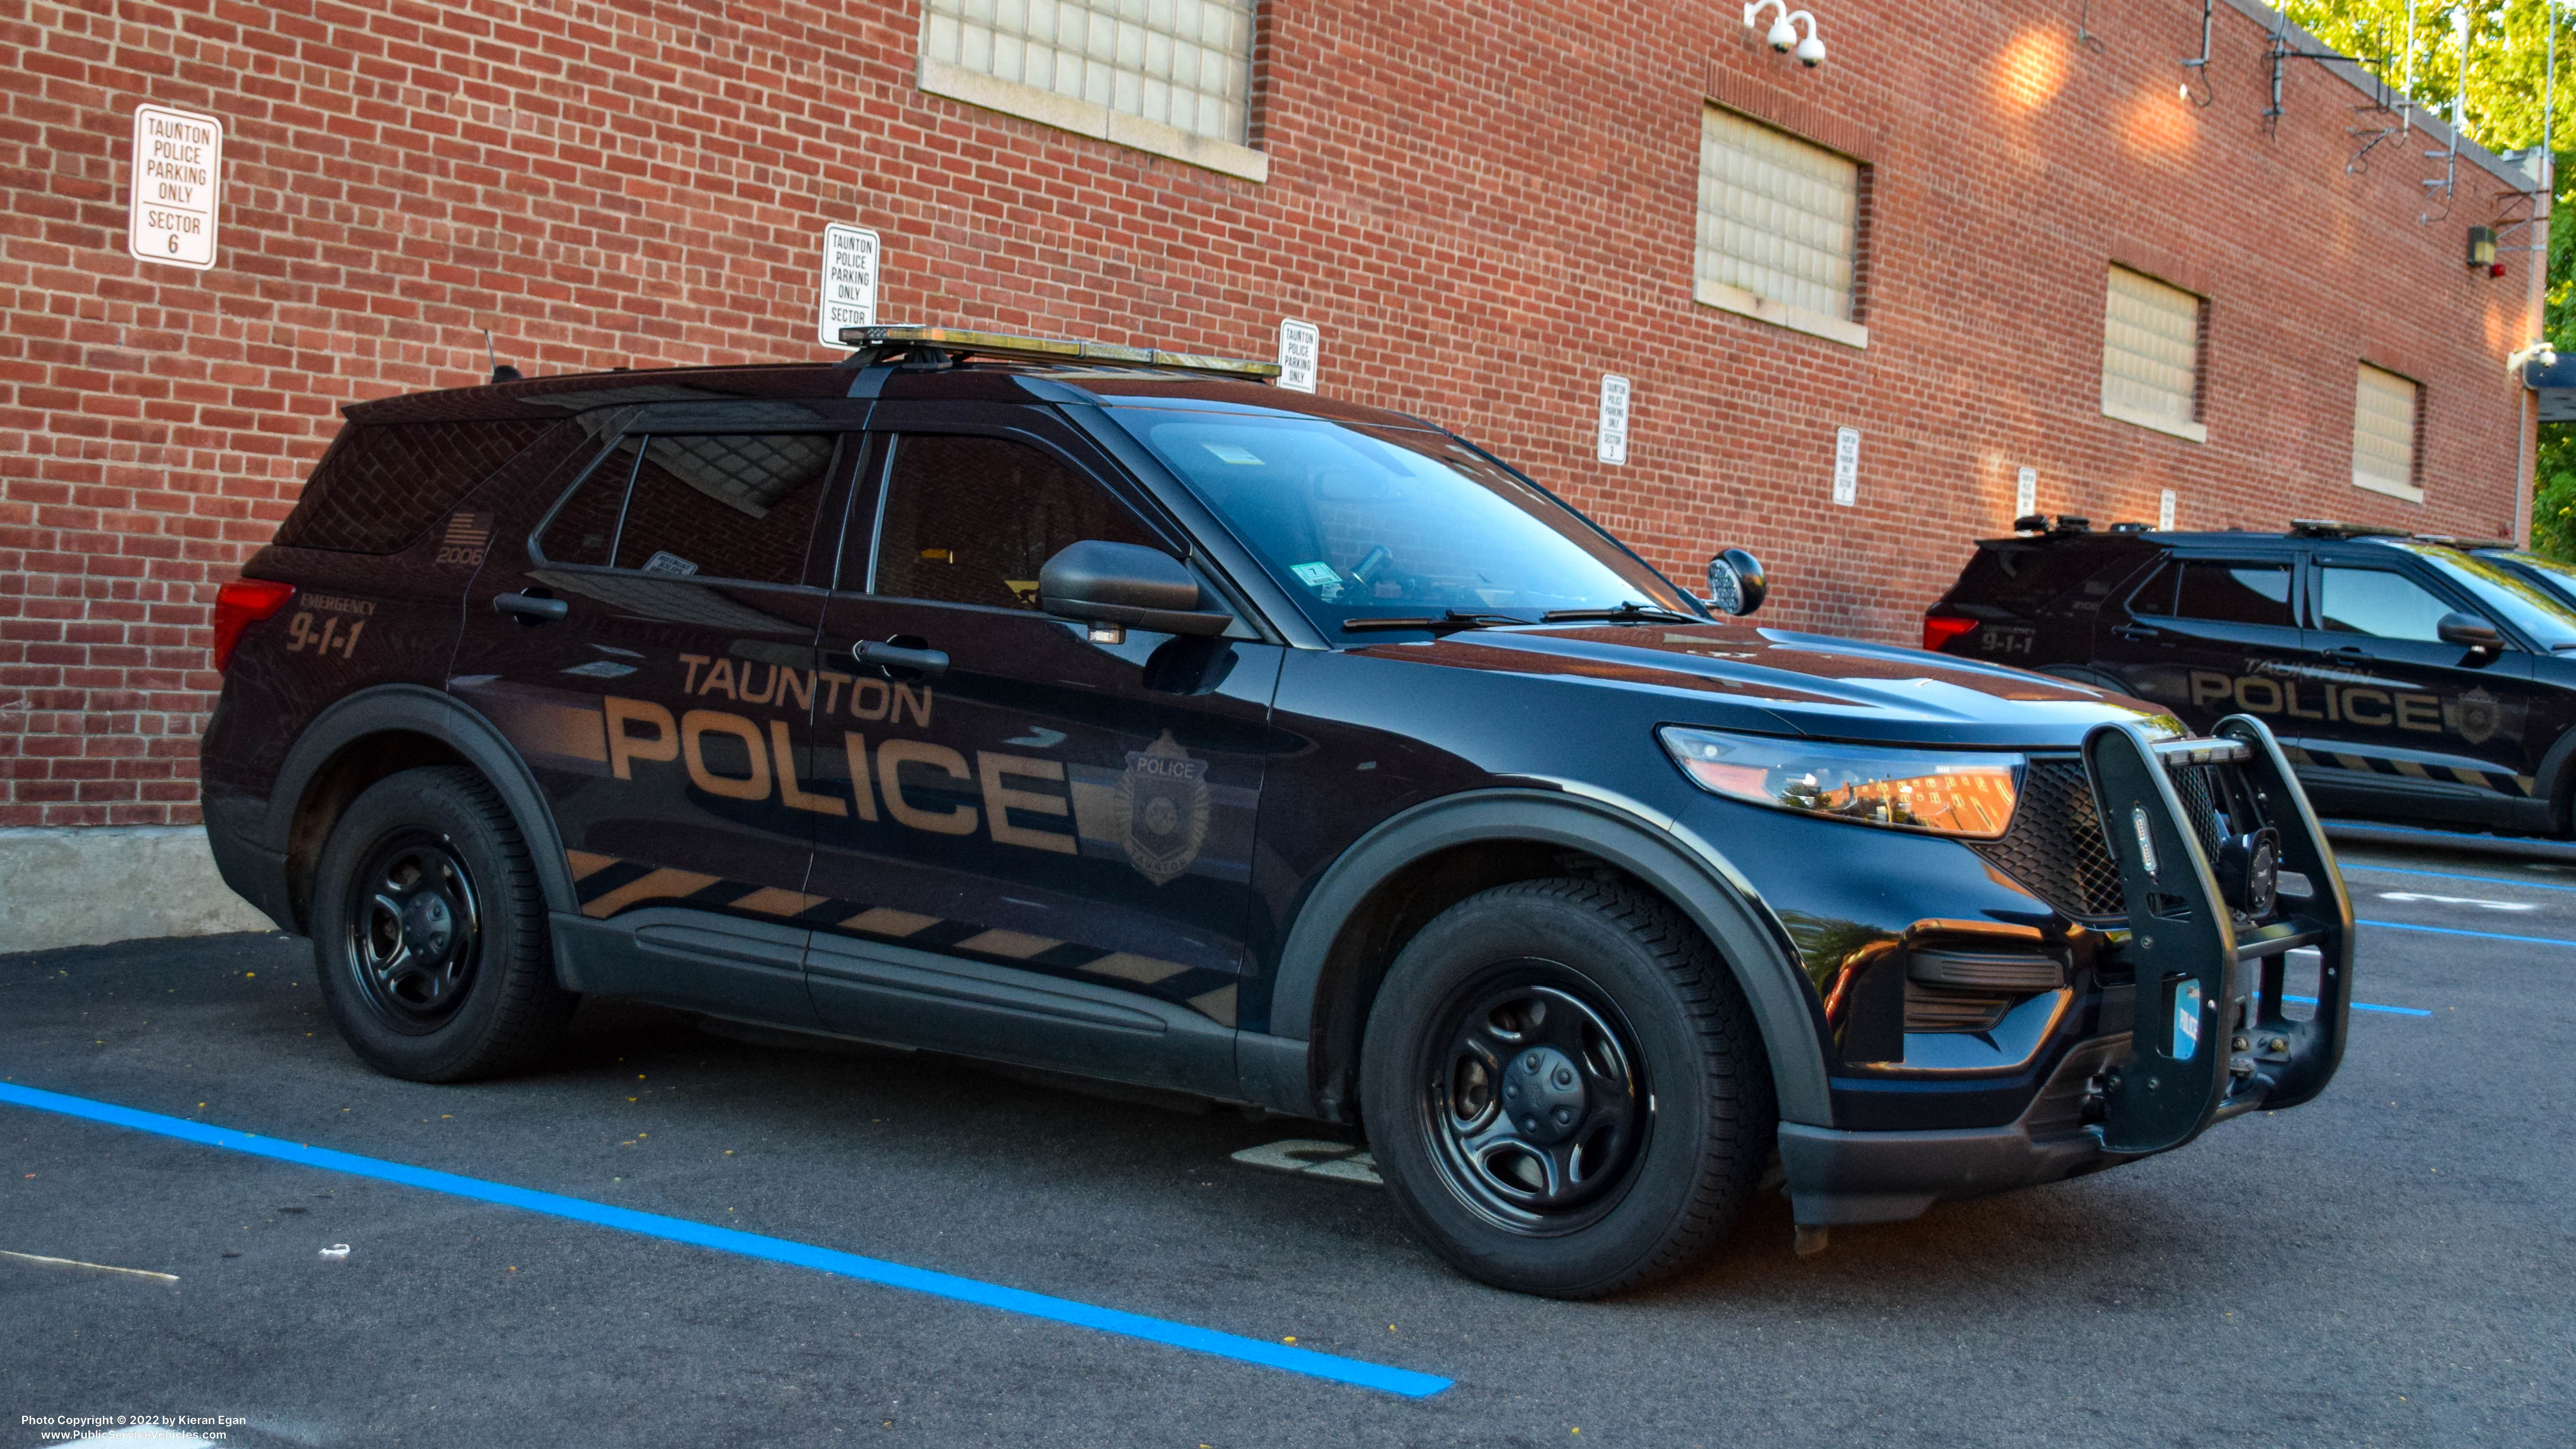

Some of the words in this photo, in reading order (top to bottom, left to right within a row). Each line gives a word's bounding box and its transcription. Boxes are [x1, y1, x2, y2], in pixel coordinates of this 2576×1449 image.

[149, 118, 211, 146] TAUNTON
[155, 140, 201, 164] POLICE
[147, 160, 206, 186] PARKING
[159, 183, 193, 203] ONLY
[149, 211, 201, 235] SECTOR
[168, 234, 179, 253] 6
[833, 234, 872, 254] TAUNTON
[836, 252, 866, 269] POLICE
[831, 267, 869, 286] PARKING
[838, 284, 861, 300] ONLY
[831, 307, 865, 324] SECTOR
[1286, 328, 1314, 344] TAUNTON
[1288, 342, 1309, 357] POLICE
[1284, 355, 1311, 371] PARKING
[1289, 370, 1305, 383] ONLY
[300, 592, 377, 616] EMERGENCY
[286, 612, 365, 659] 9-1-1
[1981, 632, 2034, 654] 9-1-1
[679, 654, 933, 728] TAUNTON
[2190, 670, 2442, 733] POLICE
[604, 695, 1078, 856] POLICE
[1137, 757, 1195, 779] POLICE
